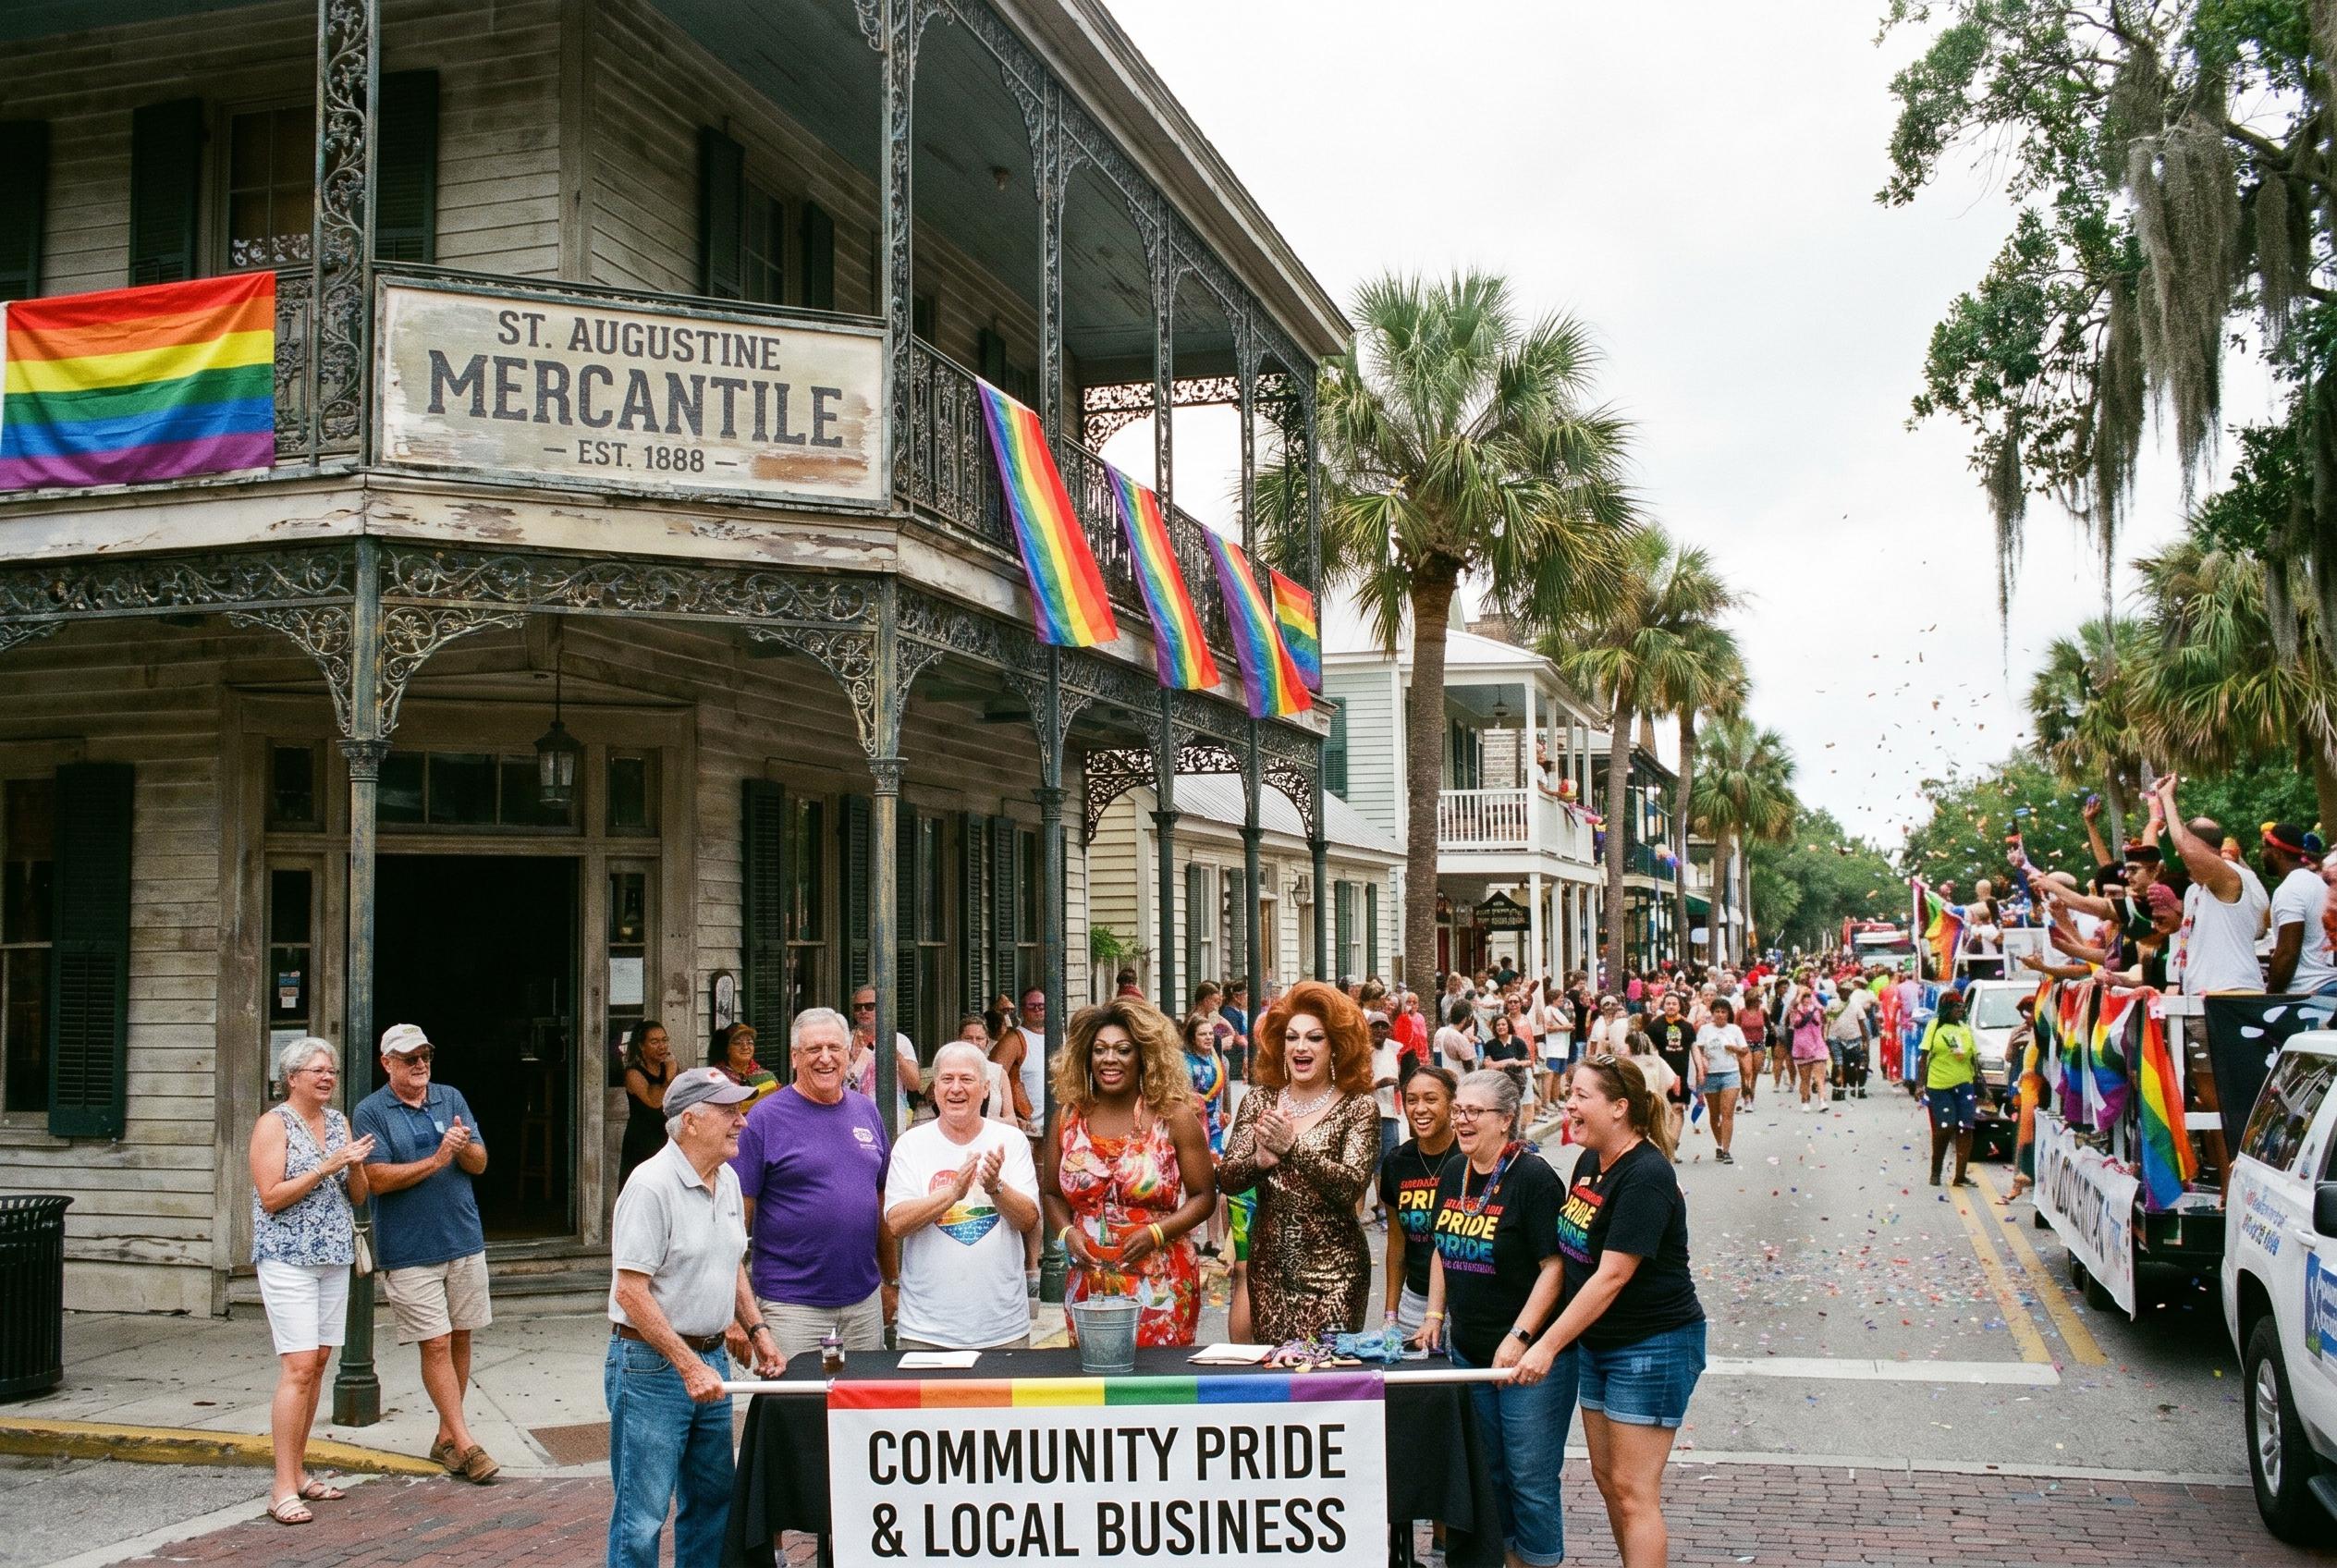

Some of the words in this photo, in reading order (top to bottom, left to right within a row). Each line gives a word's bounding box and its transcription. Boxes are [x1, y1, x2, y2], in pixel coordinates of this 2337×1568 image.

[497, 310, 552, 349] ST.
[567, 317, 781, 372] AUGUSTINE
[427, 349, 843, 448] MERCANTILE
[578, 439, 632, 468] EST.
[644, 445, 704, 473] 1888
[1398, 1189, 1436, 1210] PRI
[1435, 1208, 1499, 1241] PRIDE
[868, 1427, 1179, 1485] COMMUNITY
[1196, 1424, 1347, 1481] PRIDE
[871, 1502, 908, 1558] &
[924, 1501, 1080, 1557] LOCAL
[1095, 1497, 1347, 1557] BUSINESS
